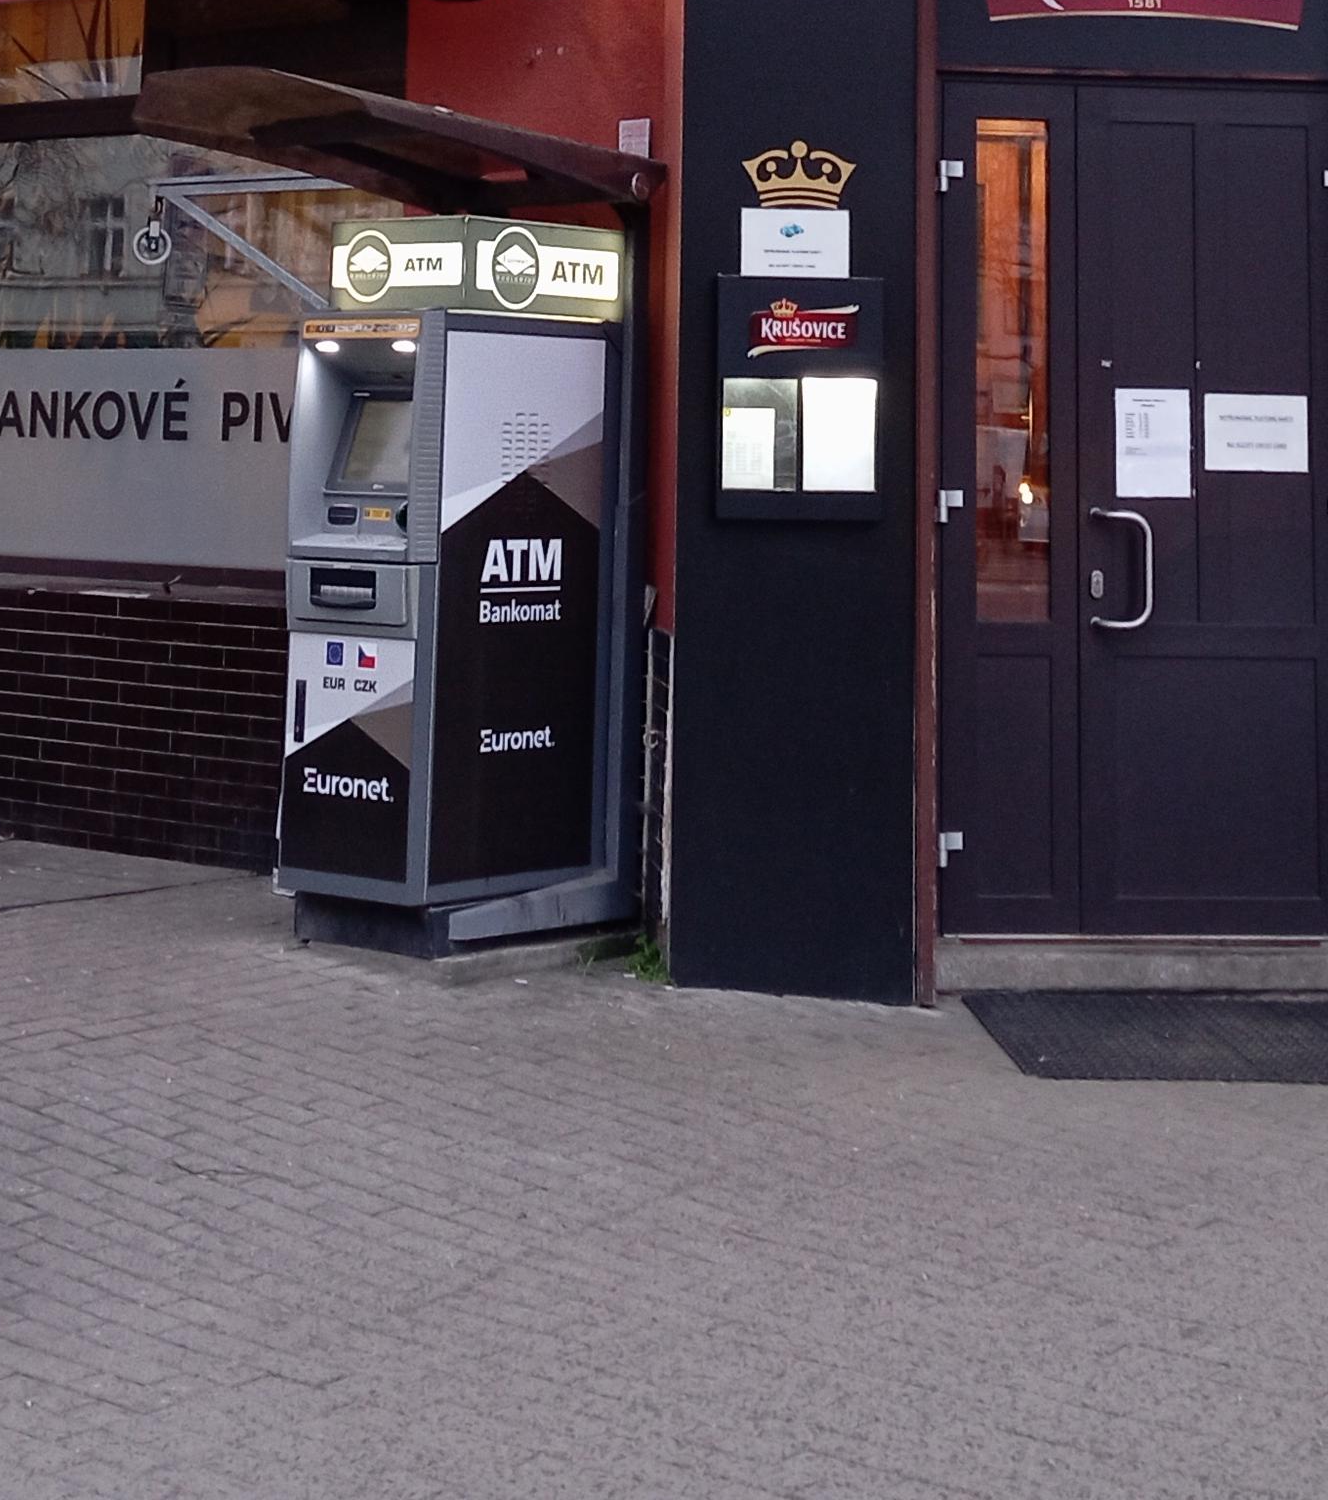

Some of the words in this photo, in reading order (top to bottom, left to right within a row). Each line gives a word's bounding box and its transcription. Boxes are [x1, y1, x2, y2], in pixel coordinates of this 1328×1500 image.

[404, 257, 443, 272] ATM
[551, 260, 604, 286] ATM
[761, 317, 847, 342] KRUŠOVICE
[221, 391, 295, 444] PIV
[480, 538, 562, 583] ATM
[479, 599, 562, 624] Bankomat
[323, 676, 345, 691] EUR
[354, 679, 377, 693] CZK
